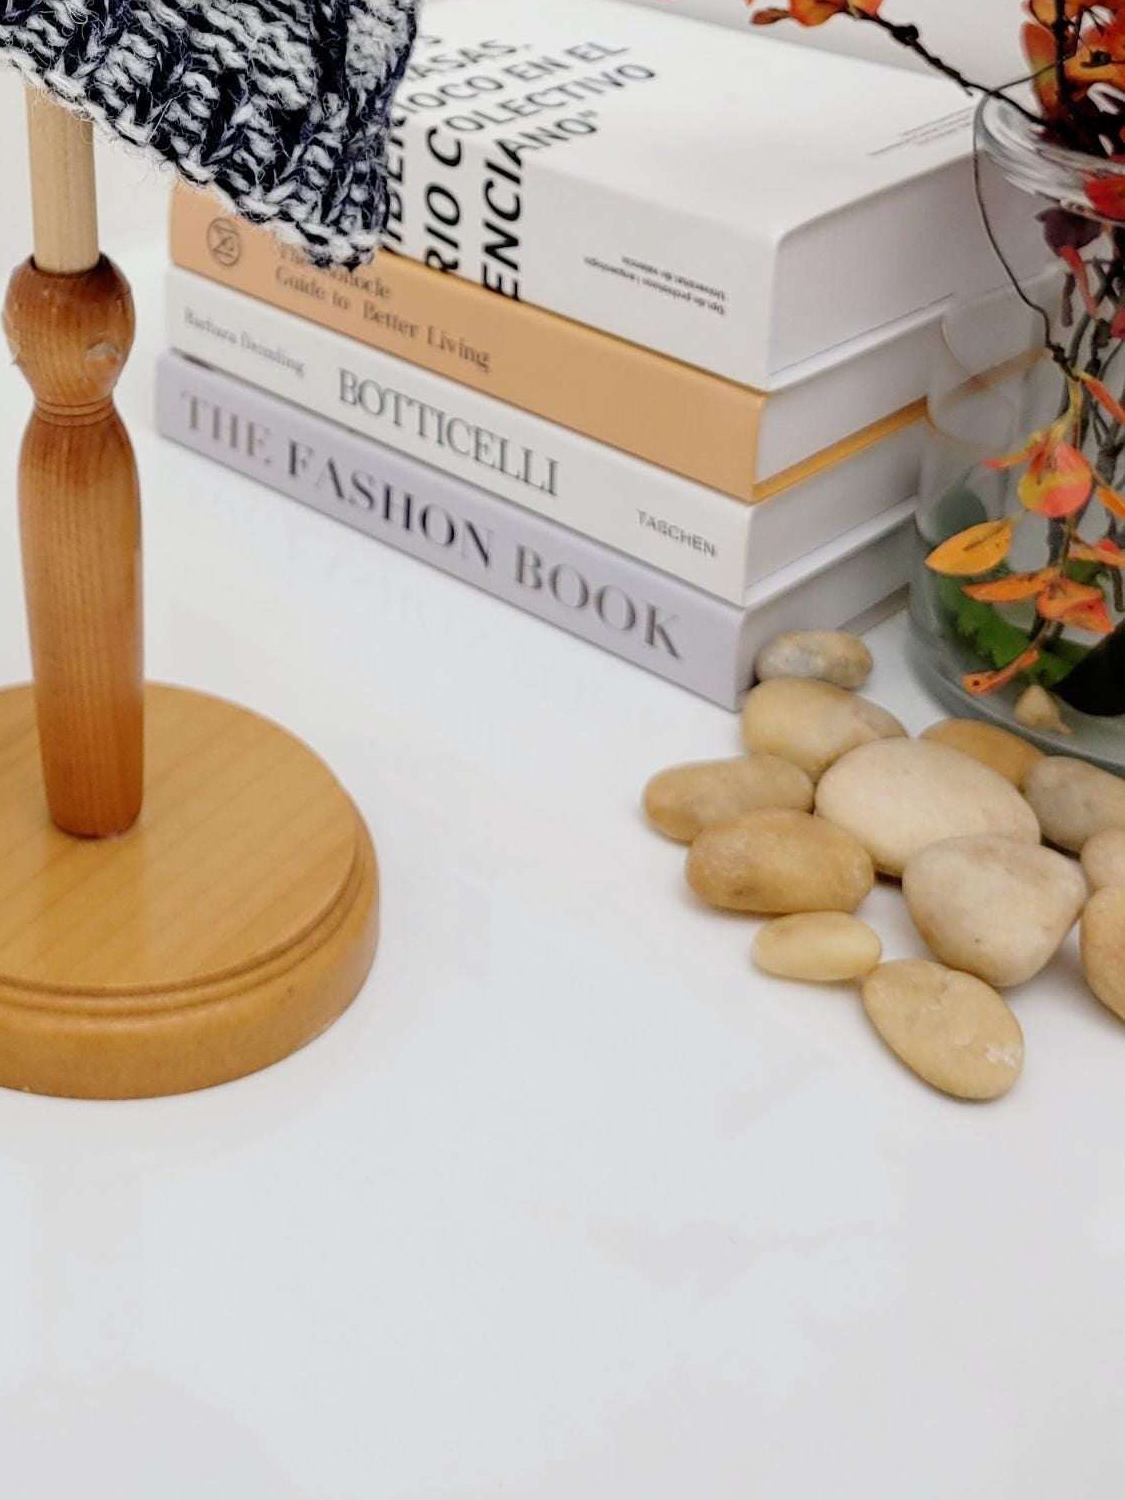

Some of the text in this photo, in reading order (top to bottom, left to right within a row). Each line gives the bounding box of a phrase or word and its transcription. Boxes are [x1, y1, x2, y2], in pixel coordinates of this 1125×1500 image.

[425, 63, 656, 168] COLECTIVO
[503, 57, 573, 82] EN
[565, 42, 629, 63] EL
[275, 266, 492, 374] Guide to Better Living
[338, 368, 560, 498] BOTTICELLI
[637, 508, 717, 558] TASCHEN
[180, 388, 272, 465] THE
[512, 542, 683, 662] BOOK
